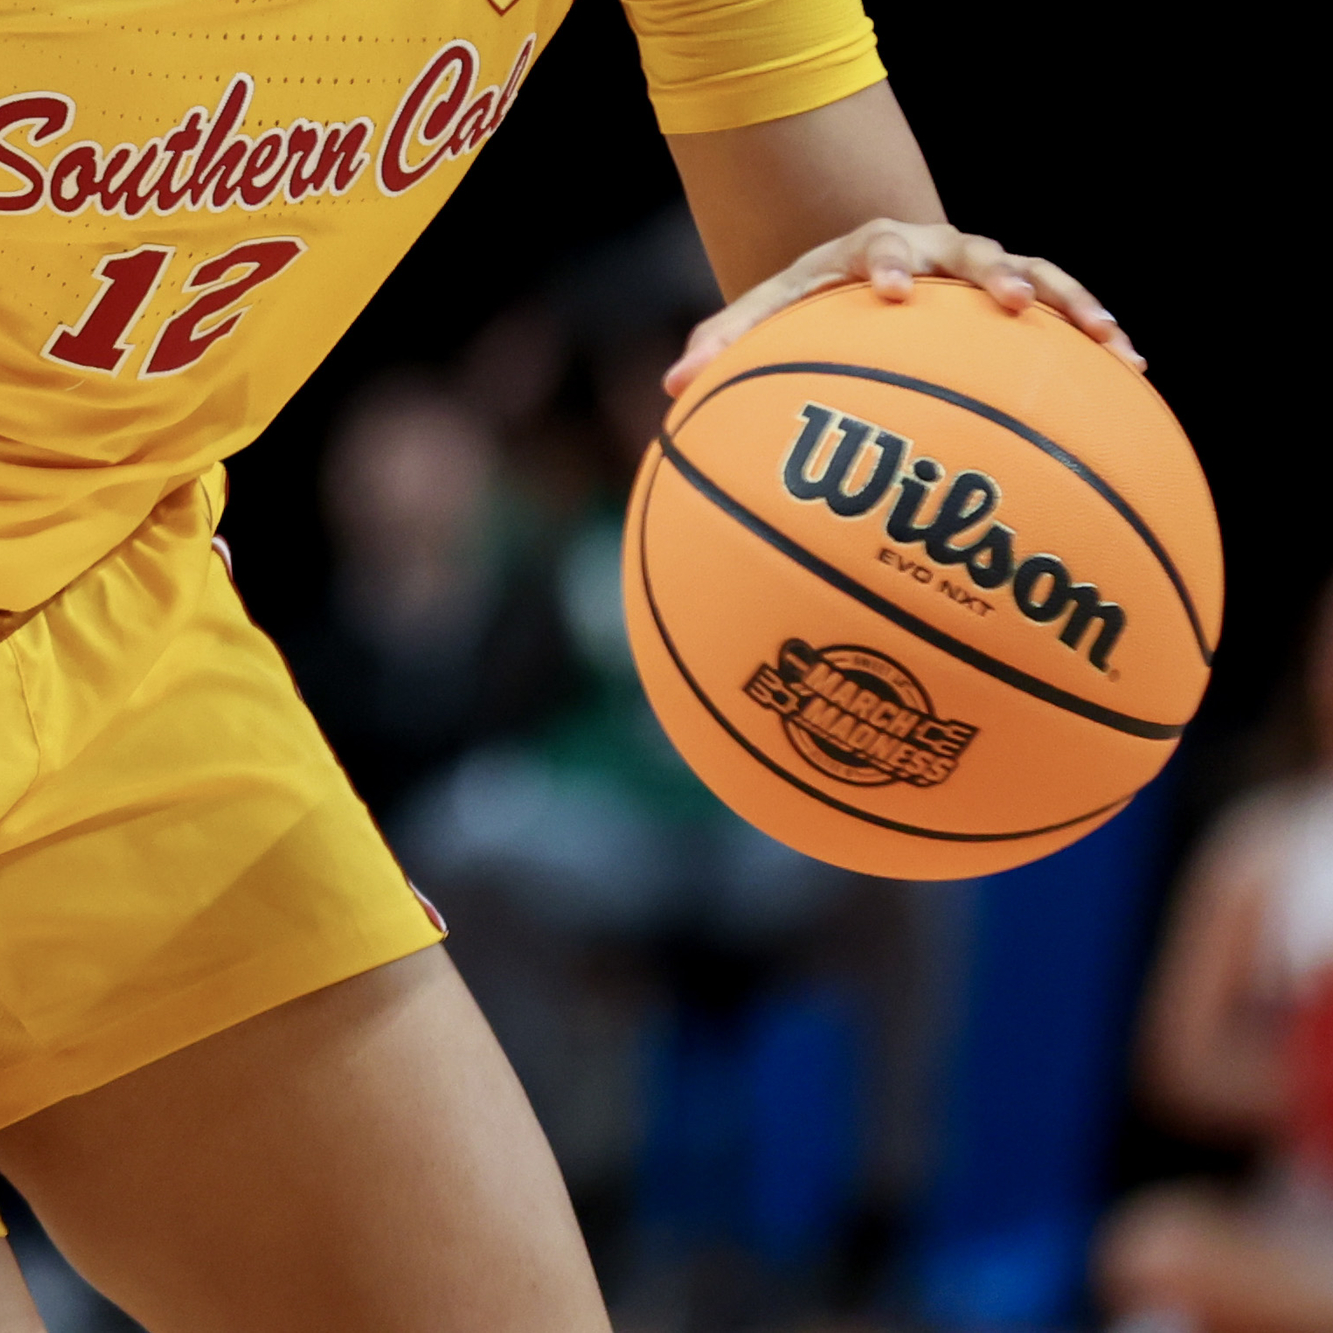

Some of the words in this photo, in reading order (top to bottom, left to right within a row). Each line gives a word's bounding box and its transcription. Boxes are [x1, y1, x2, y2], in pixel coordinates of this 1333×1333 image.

[376, 32, 537, 198] Cal
[40, 236, 309, 381] 12
[779, 400, 1128, 677] Wilson
[879, 547, 933, 585] EVO
[939, 579, 996, 618] NXT
[799, 696, 959, 785] MADNESS
[801, 661, 921, 740] MARCH
